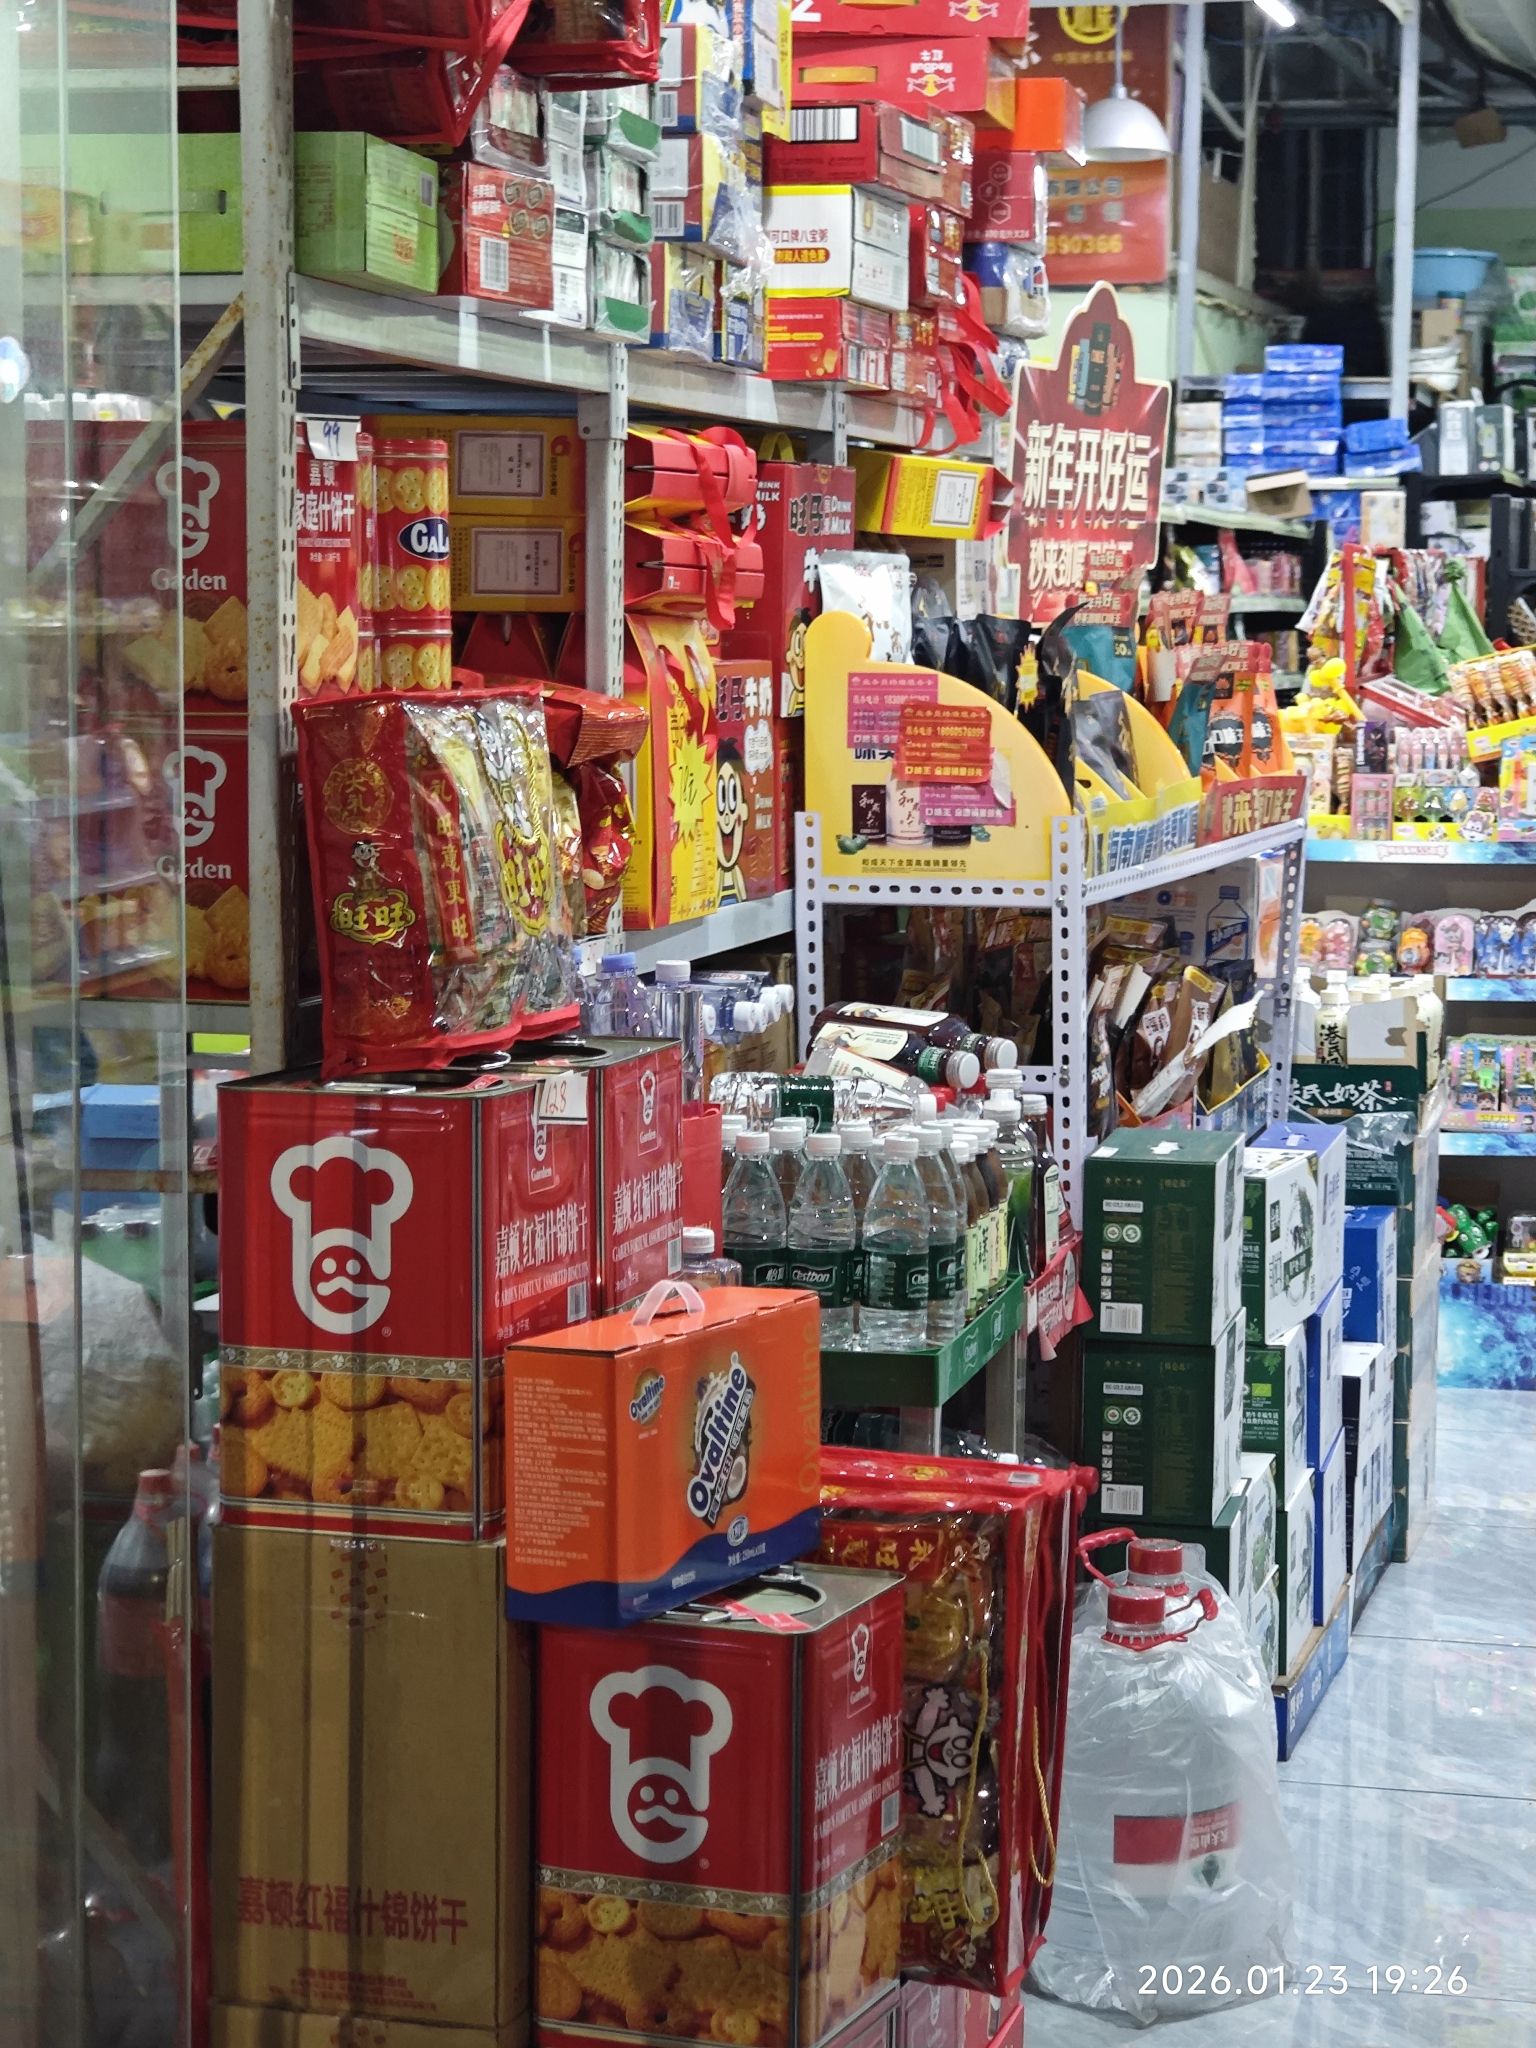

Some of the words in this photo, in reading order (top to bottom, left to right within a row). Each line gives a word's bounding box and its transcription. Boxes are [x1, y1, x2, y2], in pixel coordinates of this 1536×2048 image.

[323, 421, 341, 457] 99
[309, 460, 336, 487] 嘉顿
[756, 480, 781, 490] RINK
[1022, 420, 1154, 513] 新年开好运
[340, 901, 403, 931] 旺旺
[495, 1202, 588, 1281] 嘉顿红福什锦饼干
[630, 1374, 665, 1420] Ovaltine
[687, 1364, 748, 1518] Ovaltine
[238, 1876, 469, 1946] 嘉顿红福什锦饼干
